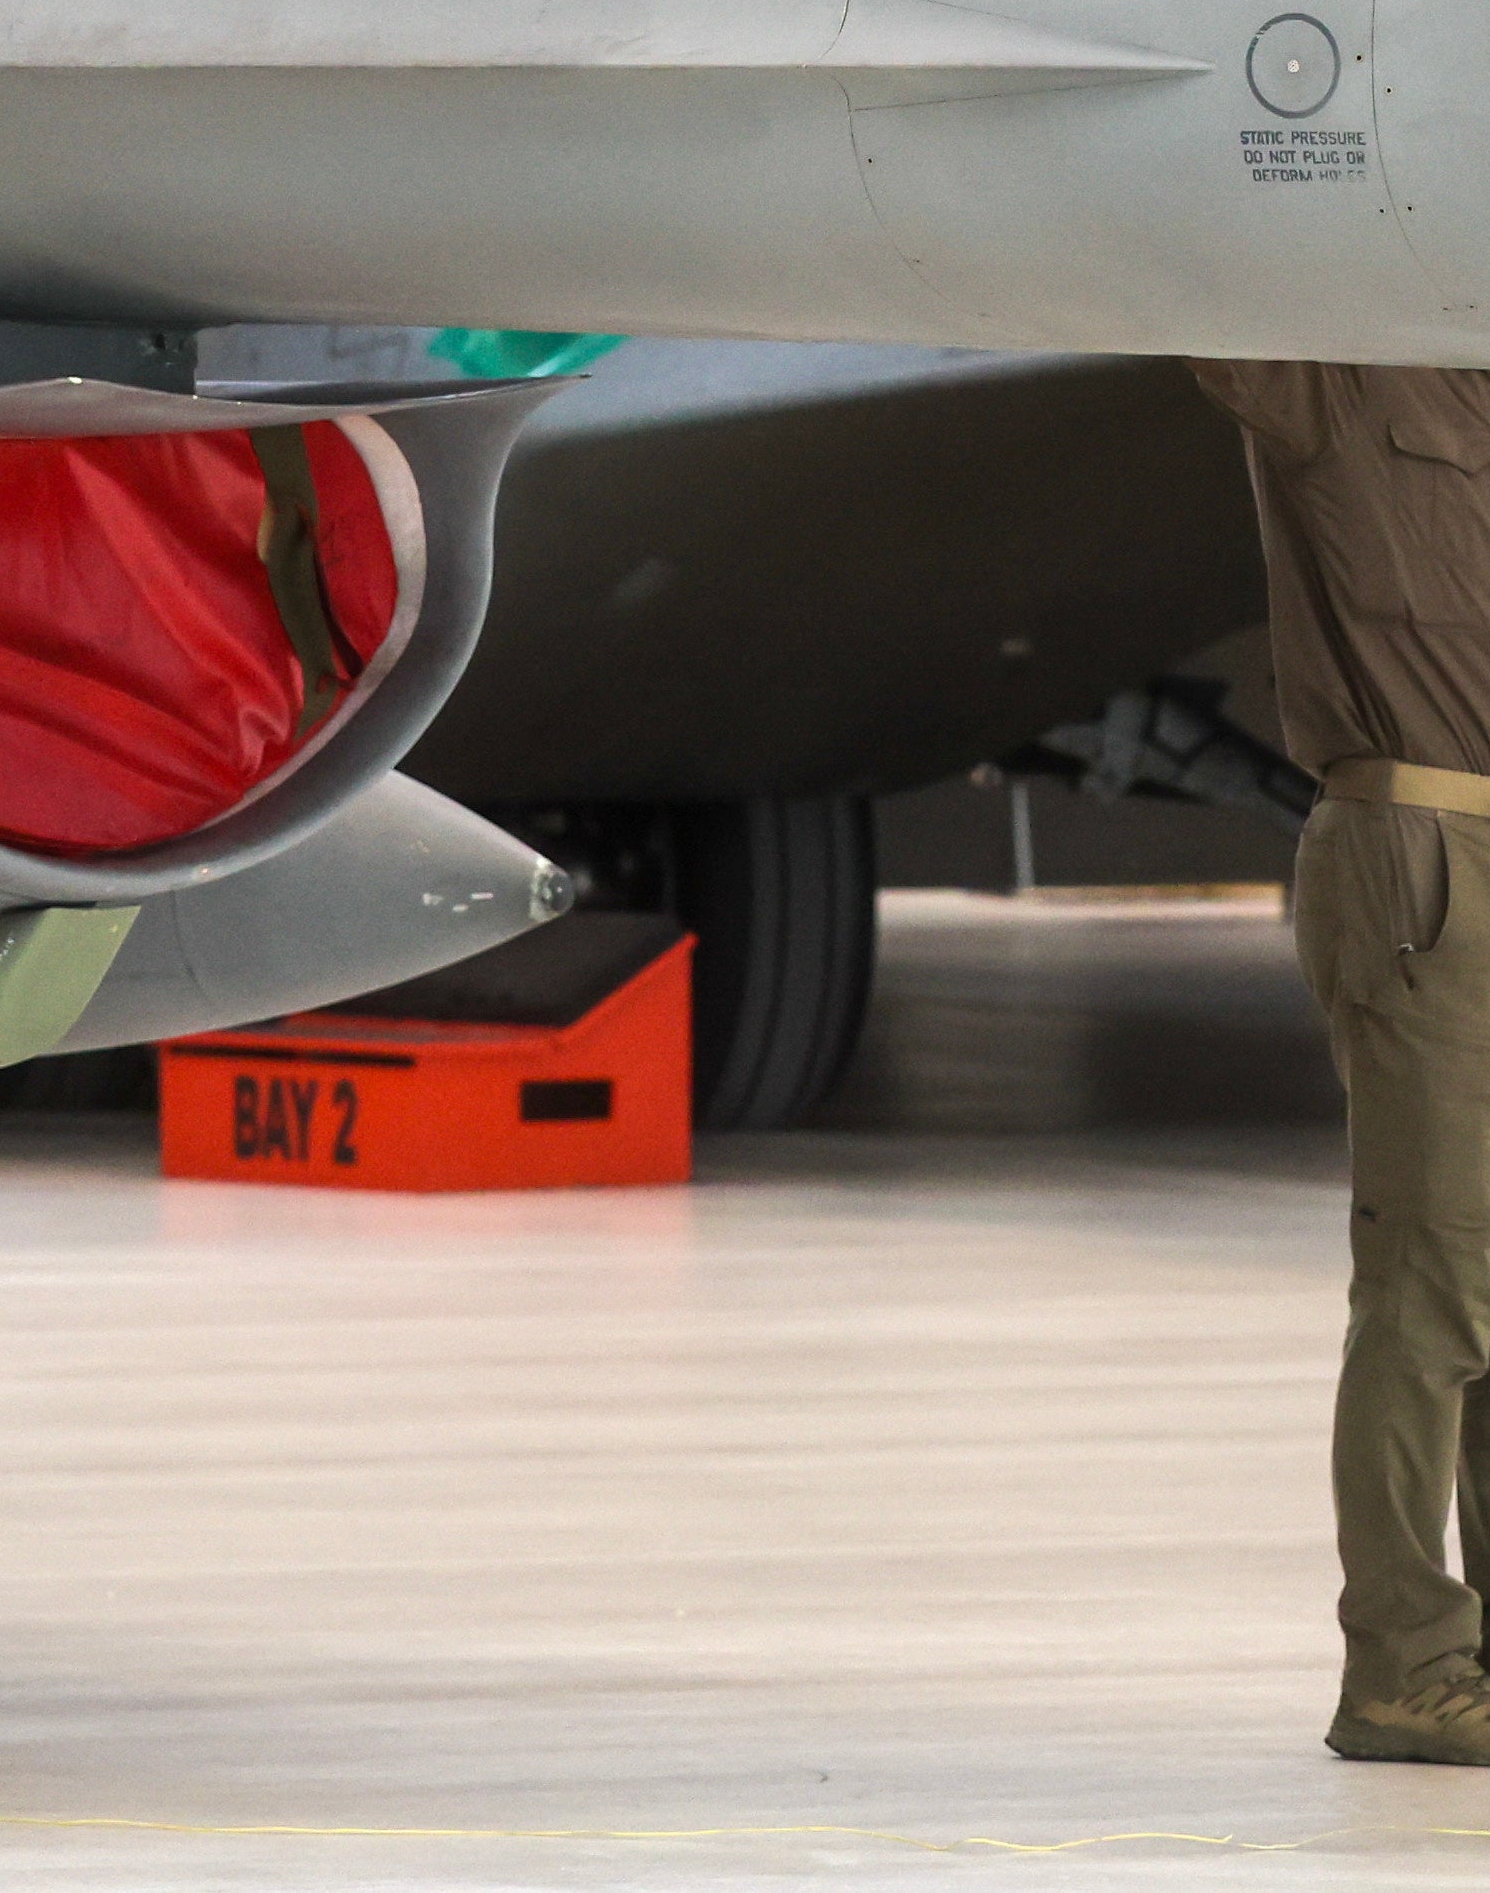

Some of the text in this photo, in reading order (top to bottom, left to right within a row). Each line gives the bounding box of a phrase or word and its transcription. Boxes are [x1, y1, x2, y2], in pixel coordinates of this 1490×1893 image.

[1240, 131, 1366, 145] STATIC PRESSURE
[1244, 151, 1365, 164] DO NOT PLUG OR
[1253, 170, 1366, 182] DEFORM HOES
[233, 1076, 359, 1164] BAY 2
